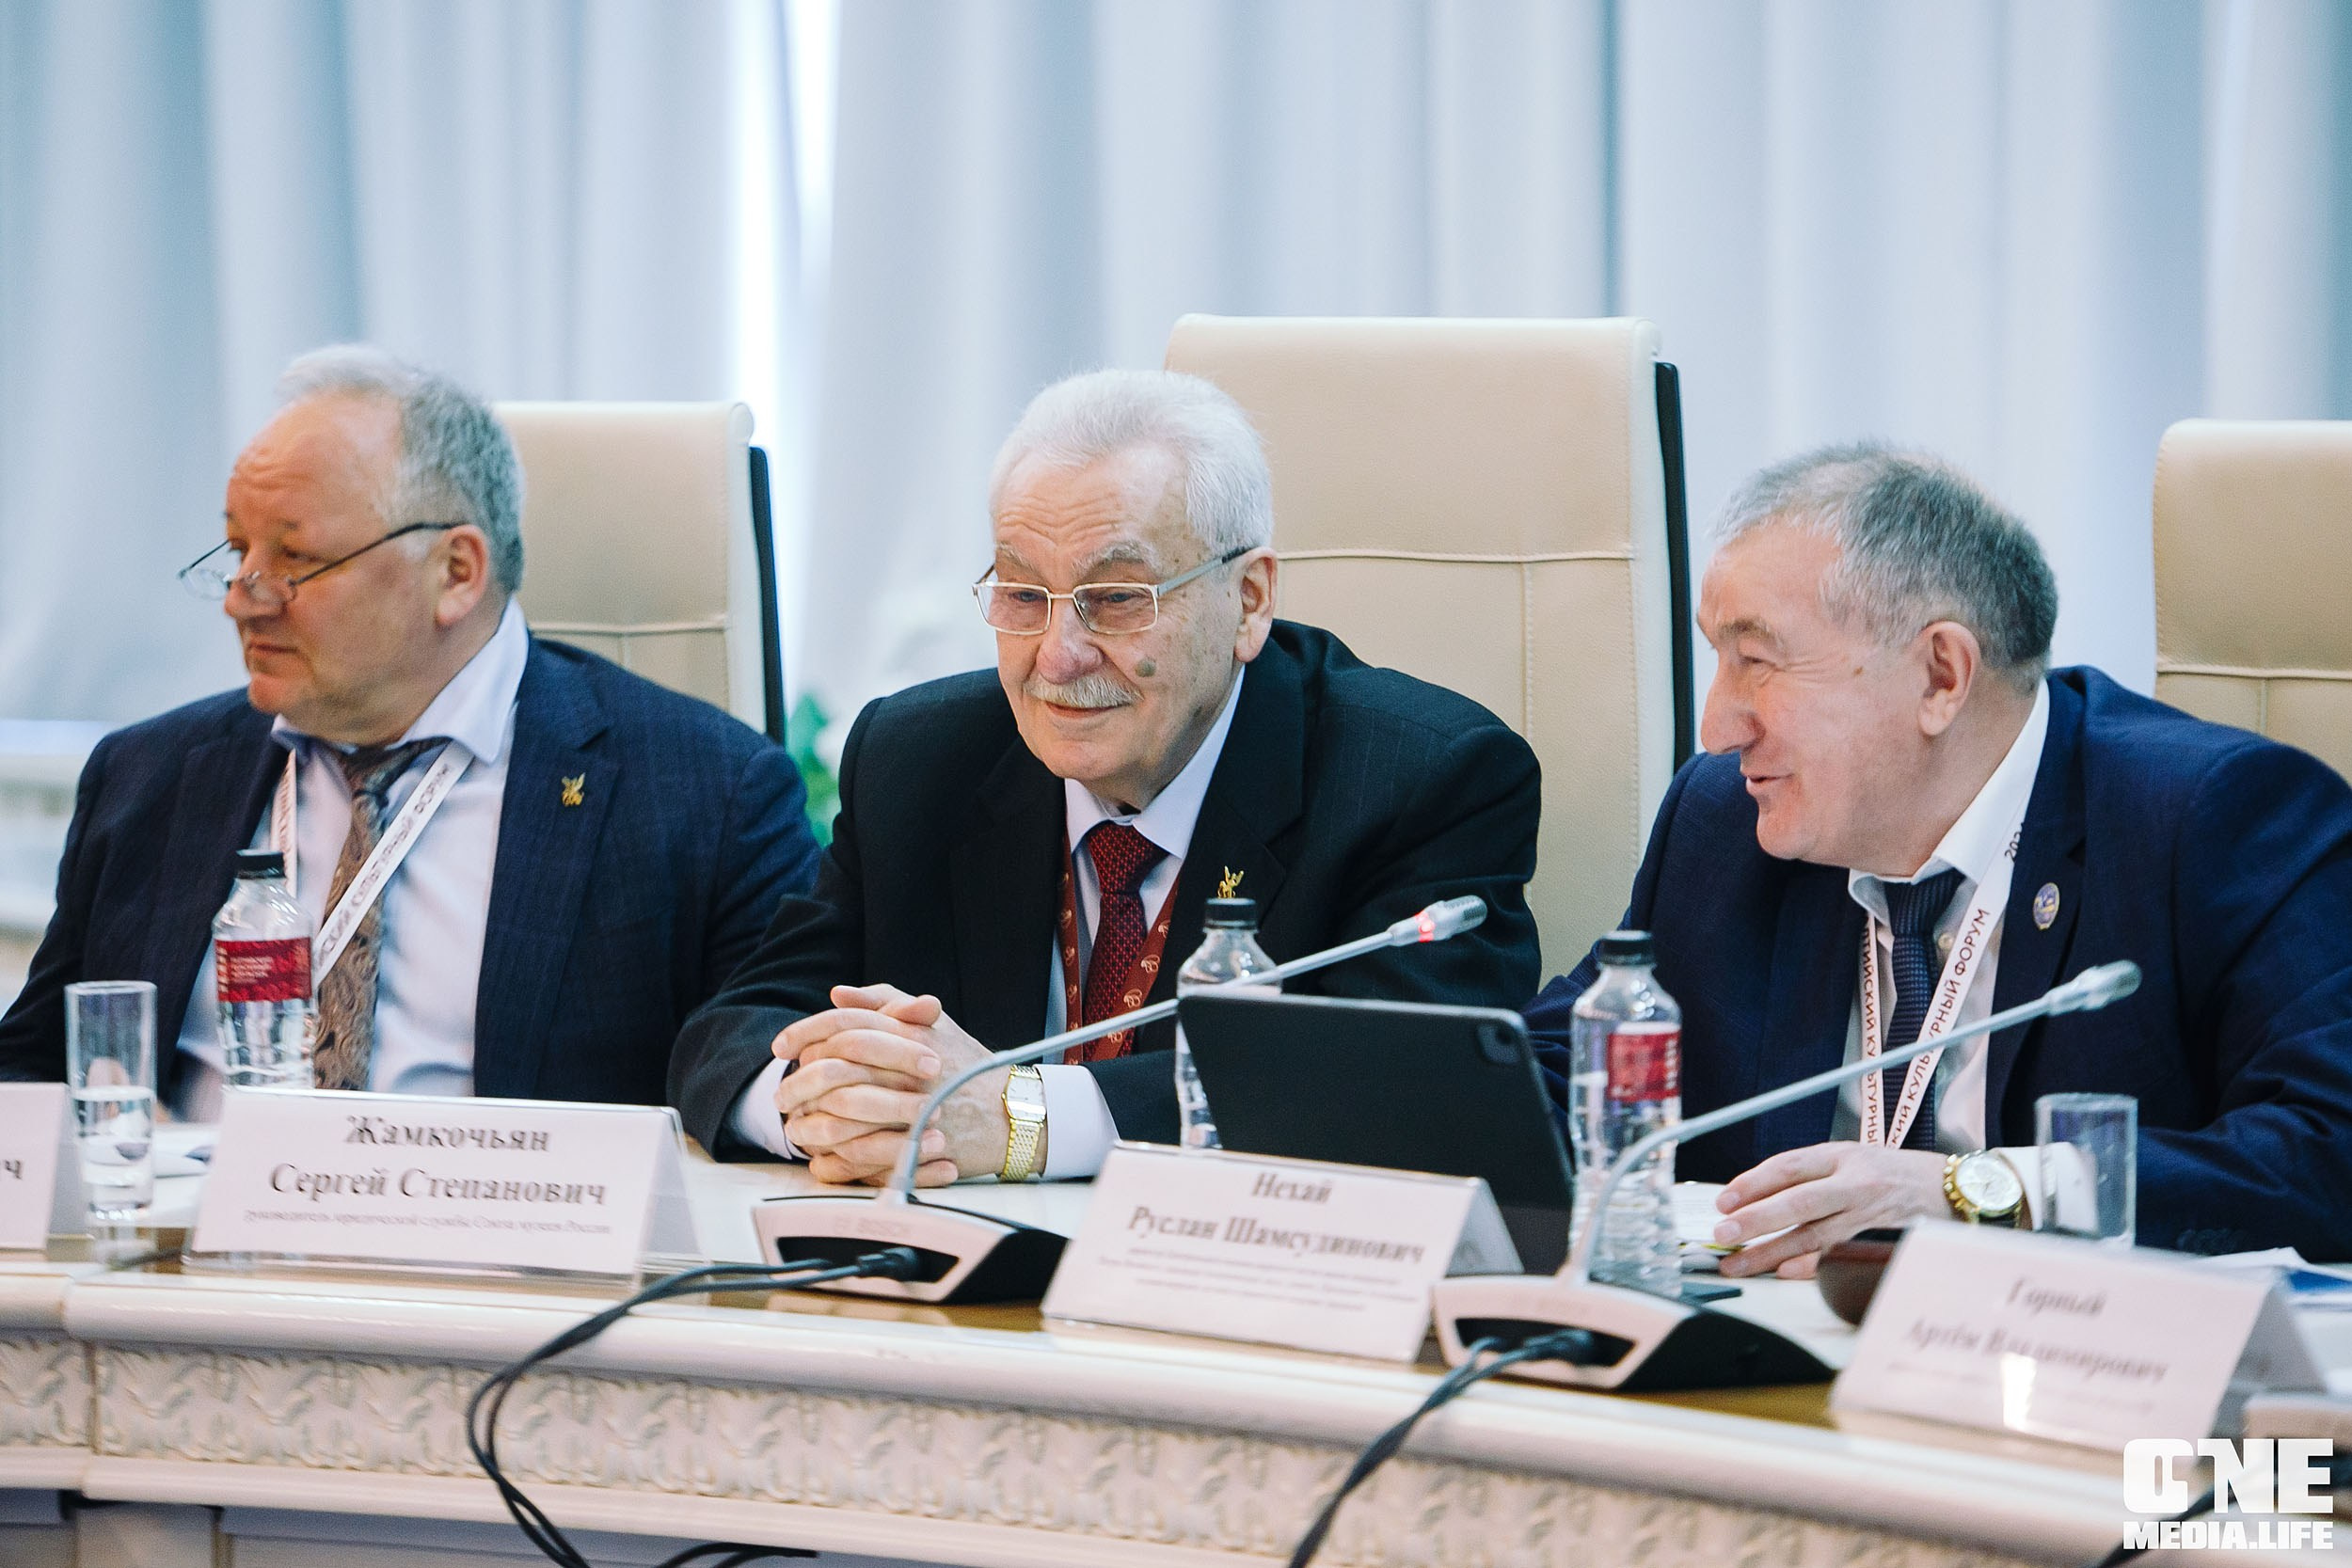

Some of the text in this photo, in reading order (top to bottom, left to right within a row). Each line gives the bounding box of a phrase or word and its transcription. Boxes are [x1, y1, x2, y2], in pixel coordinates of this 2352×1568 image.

[2004, 823, 2025, 863] 202
[1907, 979, 1962, 1101] КУЛЬРНЫЙ
[1954, 908, 1991, 976] ФОРУМ
[1867, 1036, 1878, 1144] КУЬТУРНЫ
[344, 1114, 549, 1152] Жамкочьян
[268, 1162, 608, 1206] Сергей Степанович
[1250, 1172, 1333, 1205] Нехай
[1128, 1206, 1217, 1240] Руслан
